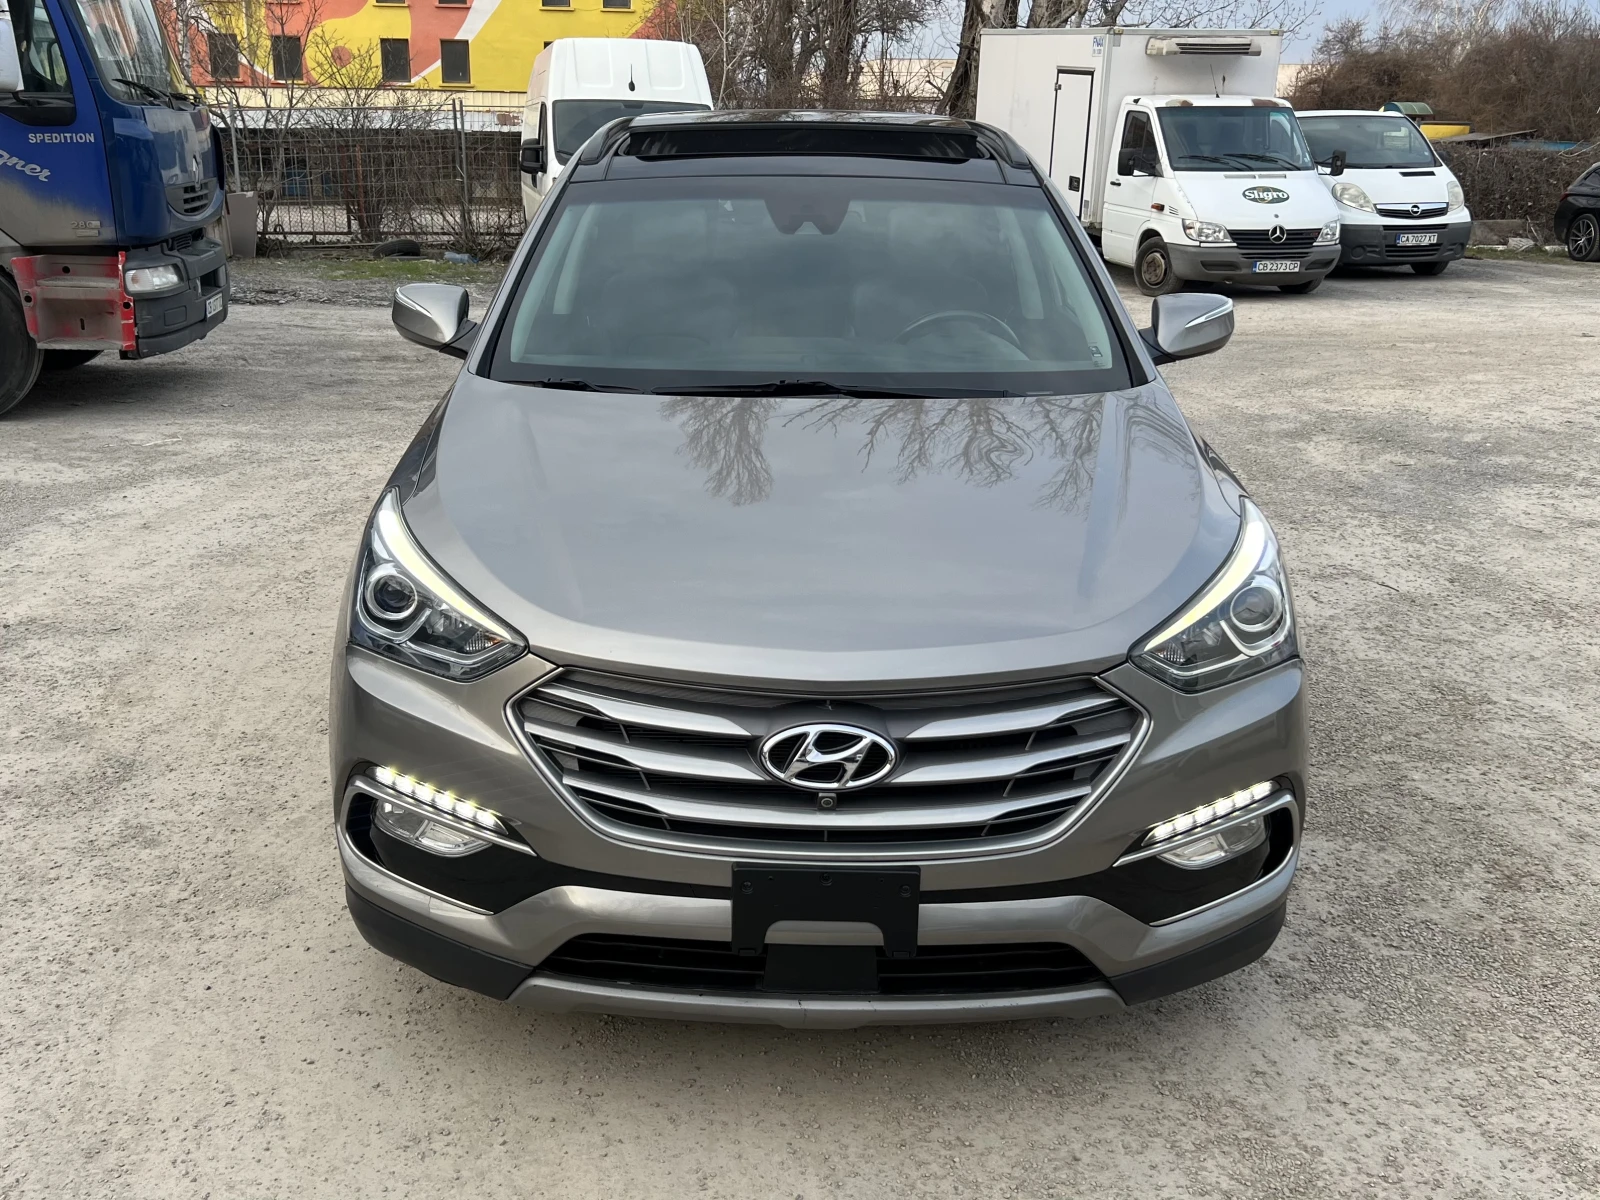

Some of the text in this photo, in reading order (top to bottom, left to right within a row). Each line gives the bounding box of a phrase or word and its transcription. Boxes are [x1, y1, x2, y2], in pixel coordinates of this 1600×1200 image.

[28, 133, 95, 143] SPEDITION
[1244, 190, 1288, 200] Sligro
[1400, 234, 1437, 243] CA 7027 XT
[1257, 262, 1299, 271] CB 2373 CP
